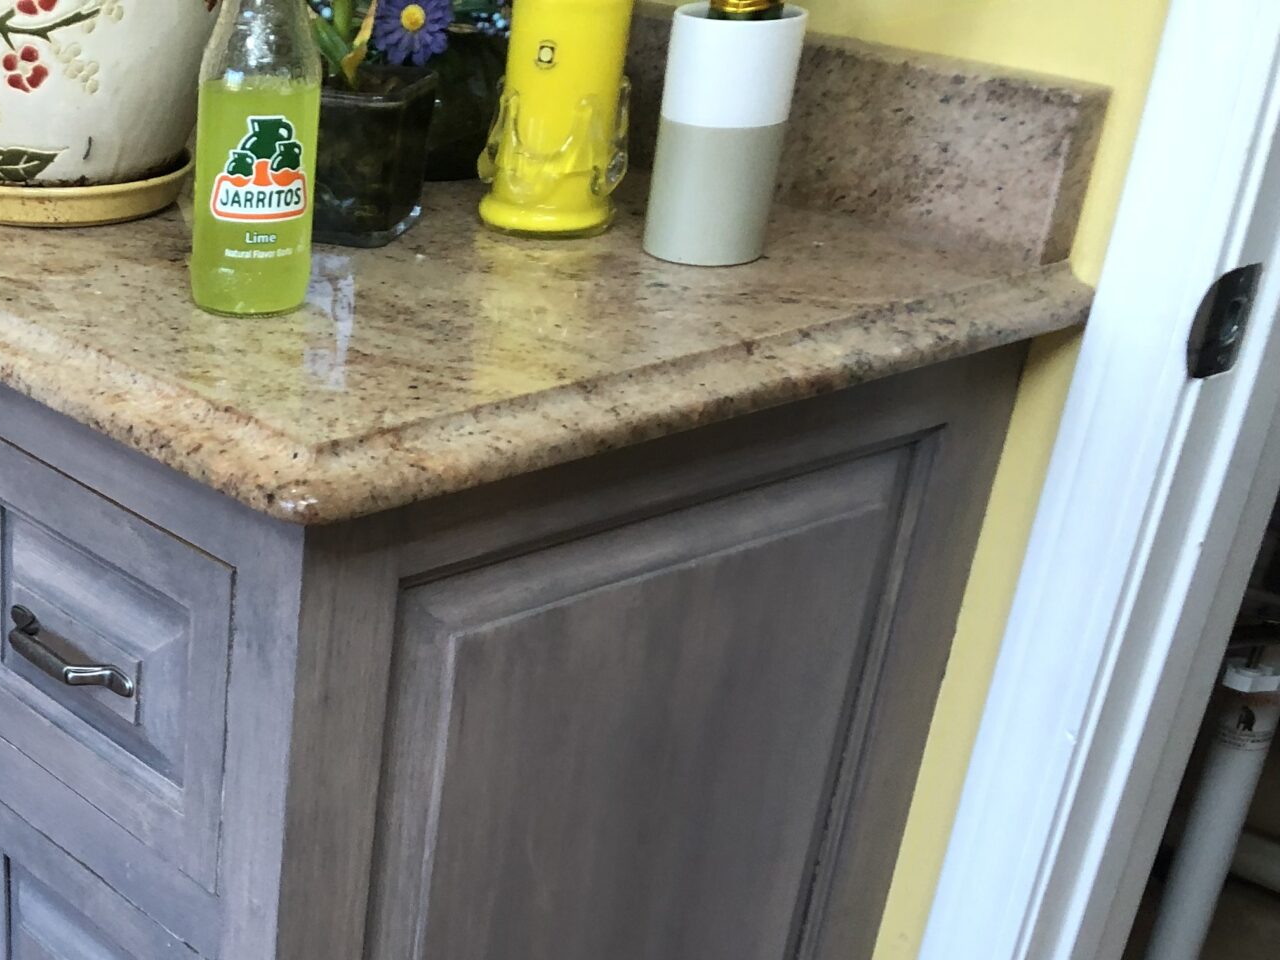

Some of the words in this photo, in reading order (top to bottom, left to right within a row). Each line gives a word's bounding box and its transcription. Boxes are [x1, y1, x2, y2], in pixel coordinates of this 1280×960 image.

[220, 187, 302, 209] JARRITOS
[245, 231, 277, 244] Lime
[224, 248, 252, 259] Natural
[253, 250, 276, 259] Flavor
